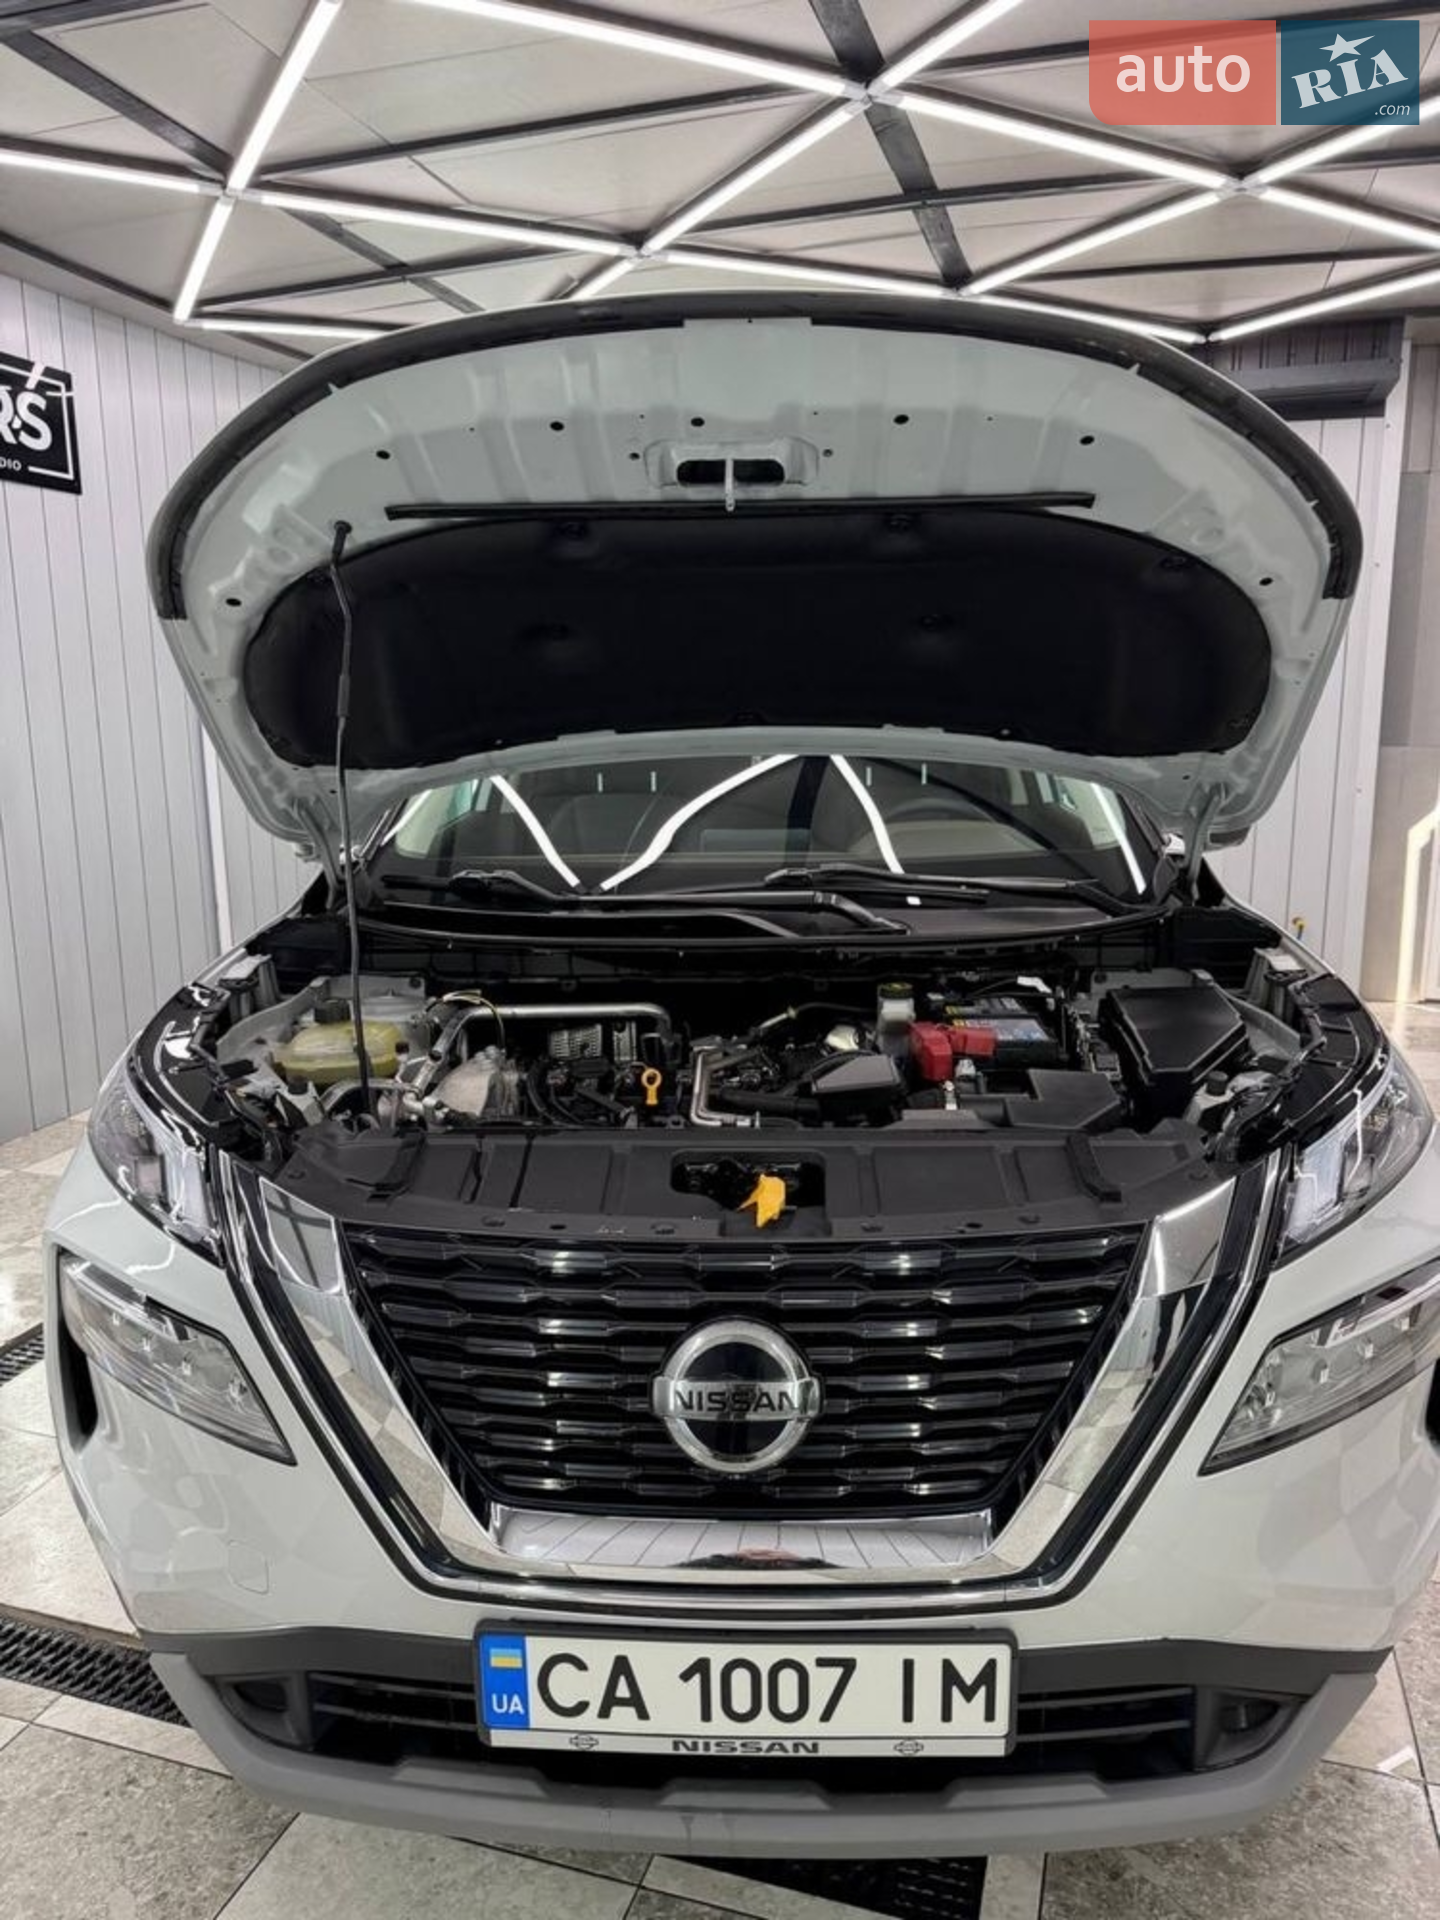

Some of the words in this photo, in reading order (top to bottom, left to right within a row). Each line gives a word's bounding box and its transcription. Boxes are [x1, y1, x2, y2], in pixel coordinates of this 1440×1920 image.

[675, 1390, 800, 1412] NISSAN
[537, 1653, 650, 1721] CA
[678, 1657, 857, 1724] 1007
[492, 1693, 525, 1715] UA
[672, 1740, 819, 1754] NISSAN
